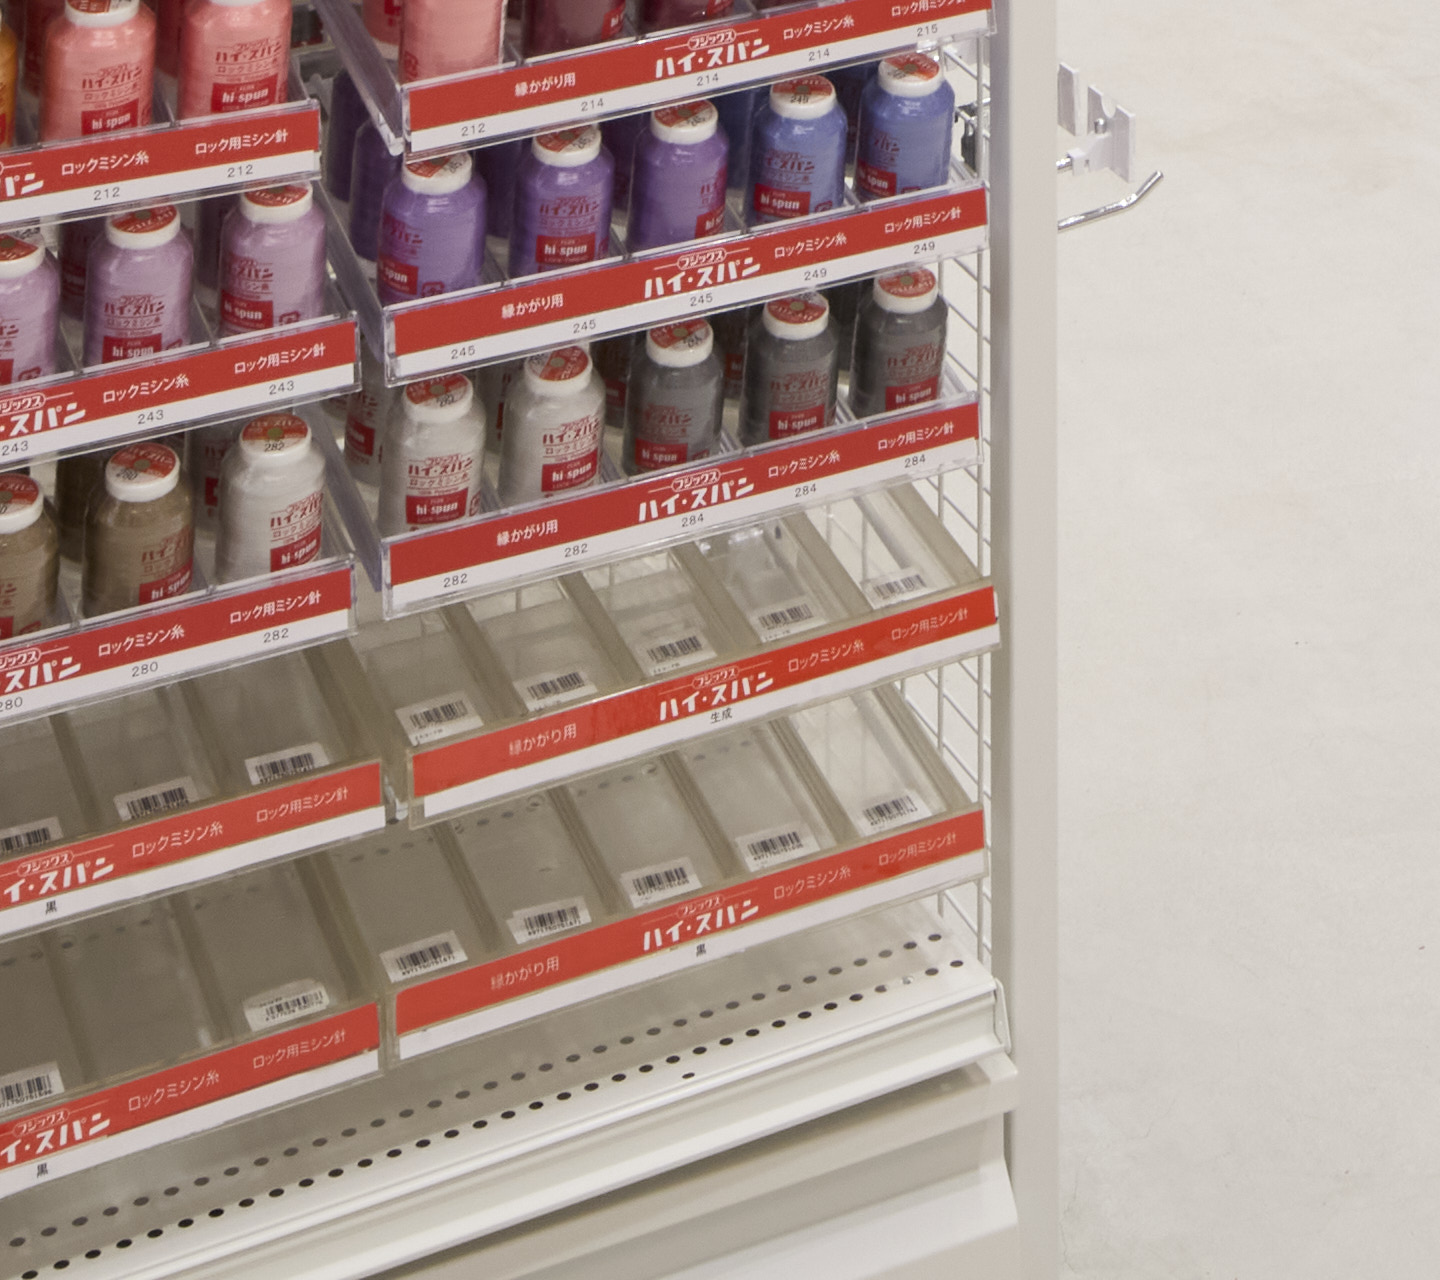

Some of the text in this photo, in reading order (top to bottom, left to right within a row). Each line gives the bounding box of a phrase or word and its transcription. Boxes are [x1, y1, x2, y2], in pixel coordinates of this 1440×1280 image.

[444, 454, 925, 588] 282 284 284
[497, 422, 954, 546] 縁かがり用 ハイ・スパン ロックミシン糸 ロック用ミシン針
[133, 822, 222, 858] ロックミシン糸
[257, 787, 348, 822] ロック用ミシン針
[46, 900, 56, 914] 黒
